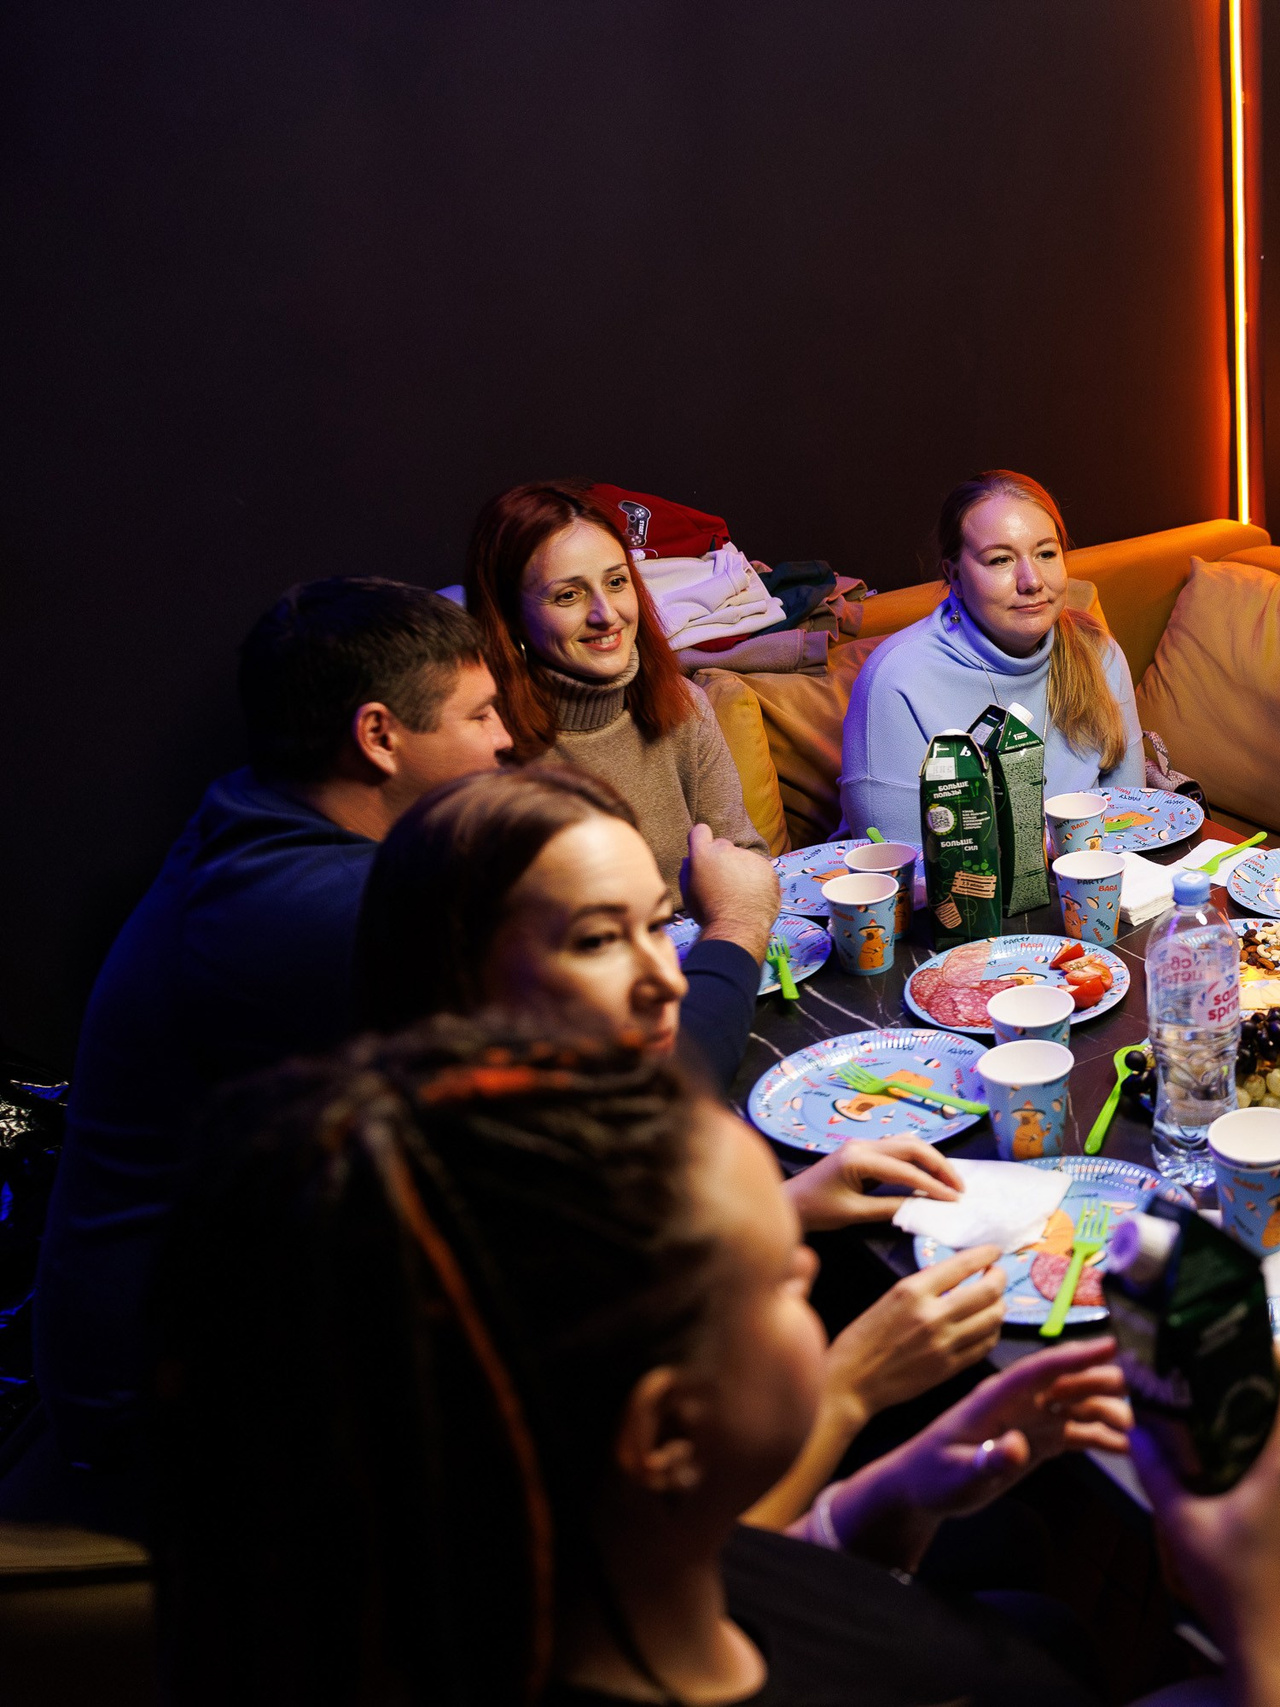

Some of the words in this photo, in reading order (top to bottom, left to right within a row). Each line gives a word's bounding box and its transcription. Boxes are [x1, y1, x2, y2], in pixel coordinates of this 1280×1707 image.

[938, 780, 970, 792] БОЛЬШЕ
[933, 789, 963, 799] ПОЛЬЗЫ
[1118, 794, 1142, 802] PARTY
[1070, 820, 1090, 831] BARA
[940, 838, 974, 848] БОЛЬШЕ
[1243, 863, 1266, 878] PARTY
[1095, 918, 1110, 931] PARTY
[1093, 927, 1104, 942] BARA
[1003, 936, 1030, 945] PARTY
[947, 1048, 974, 1056] PARTY
